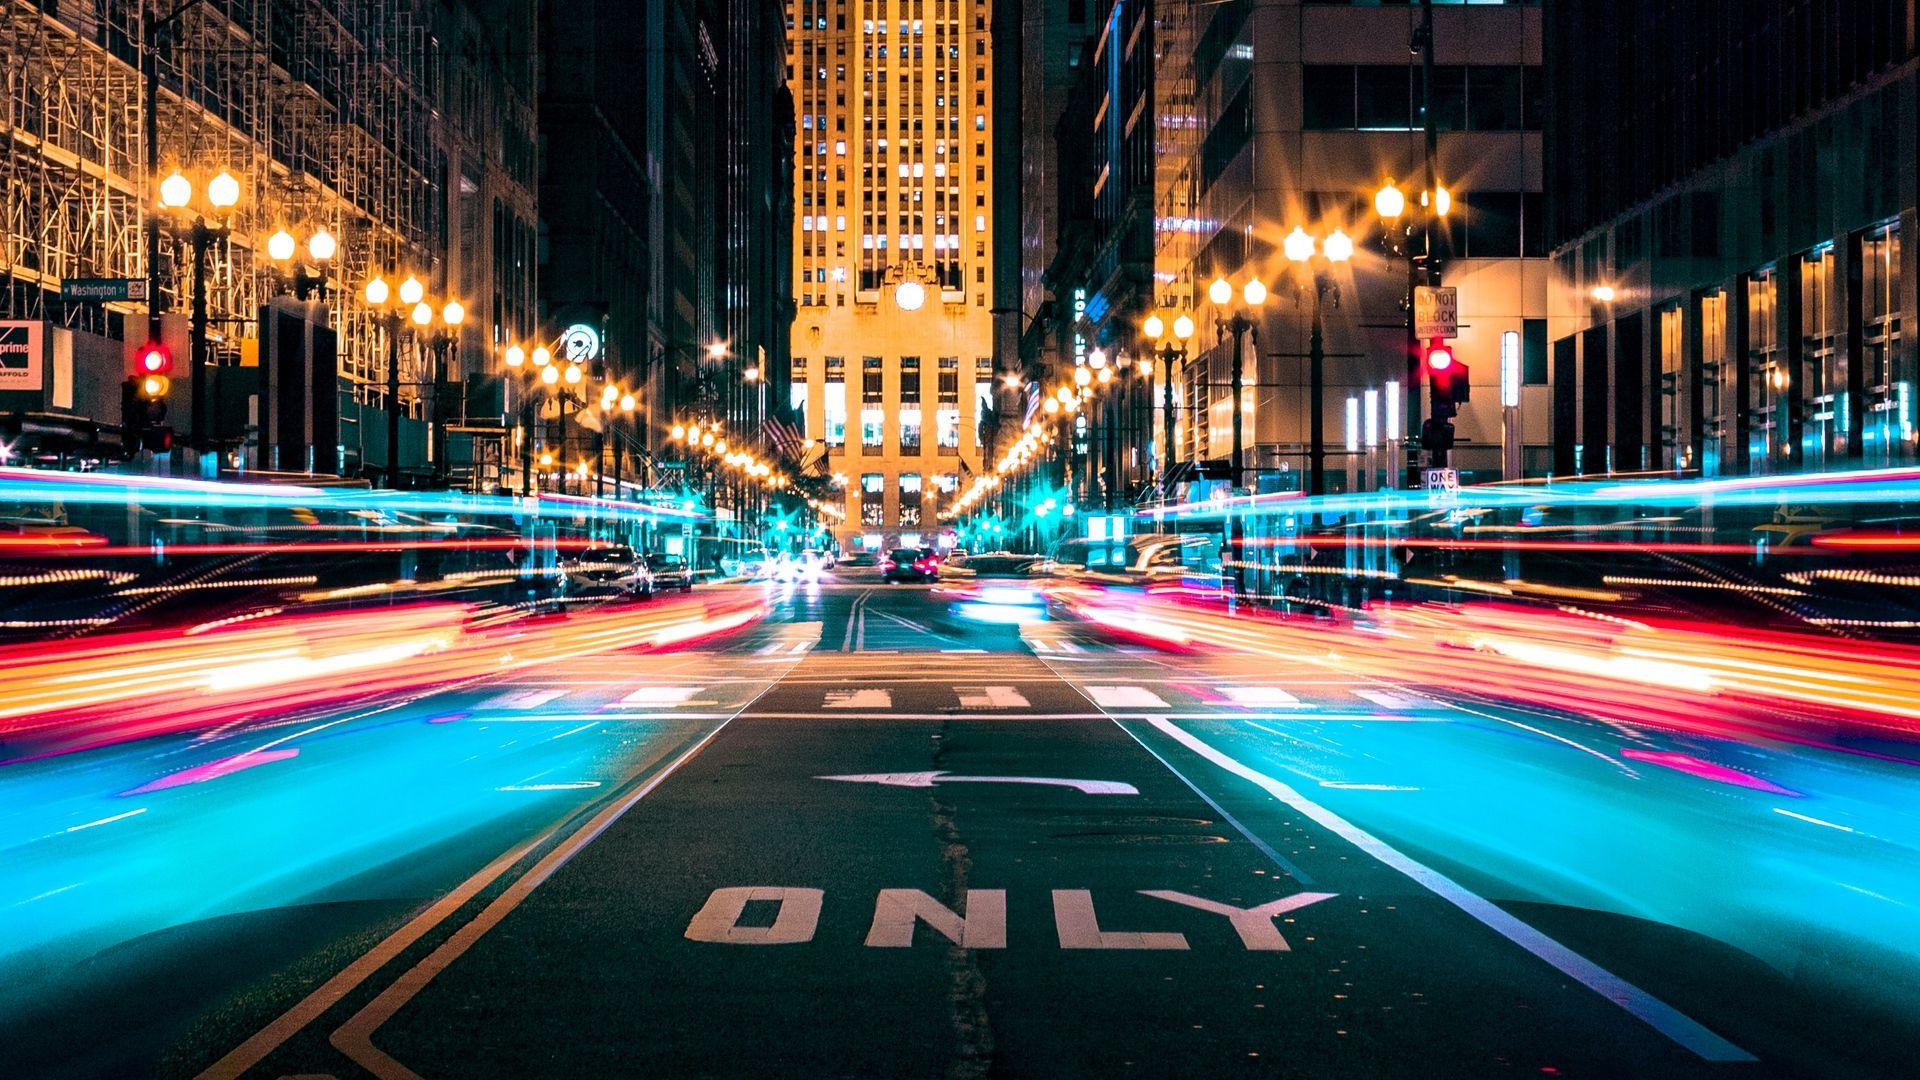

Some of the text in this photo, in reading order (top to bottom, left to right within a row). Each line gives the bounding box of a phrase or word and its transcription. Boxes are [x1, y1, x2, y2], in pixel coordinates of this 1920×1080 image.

[70, 284, 117, 299] Washington
[1418, 294, 1455, 306] DO NOT
[1418, 311, 1456, 323] BLOCK
[1418, 325, 1456, 334] INTERSECTION
[1430, 471, 1454, 482] ONE
[1430, 484, 1455, 494] WAY
[683, 886, 1340, 950] ONLY
